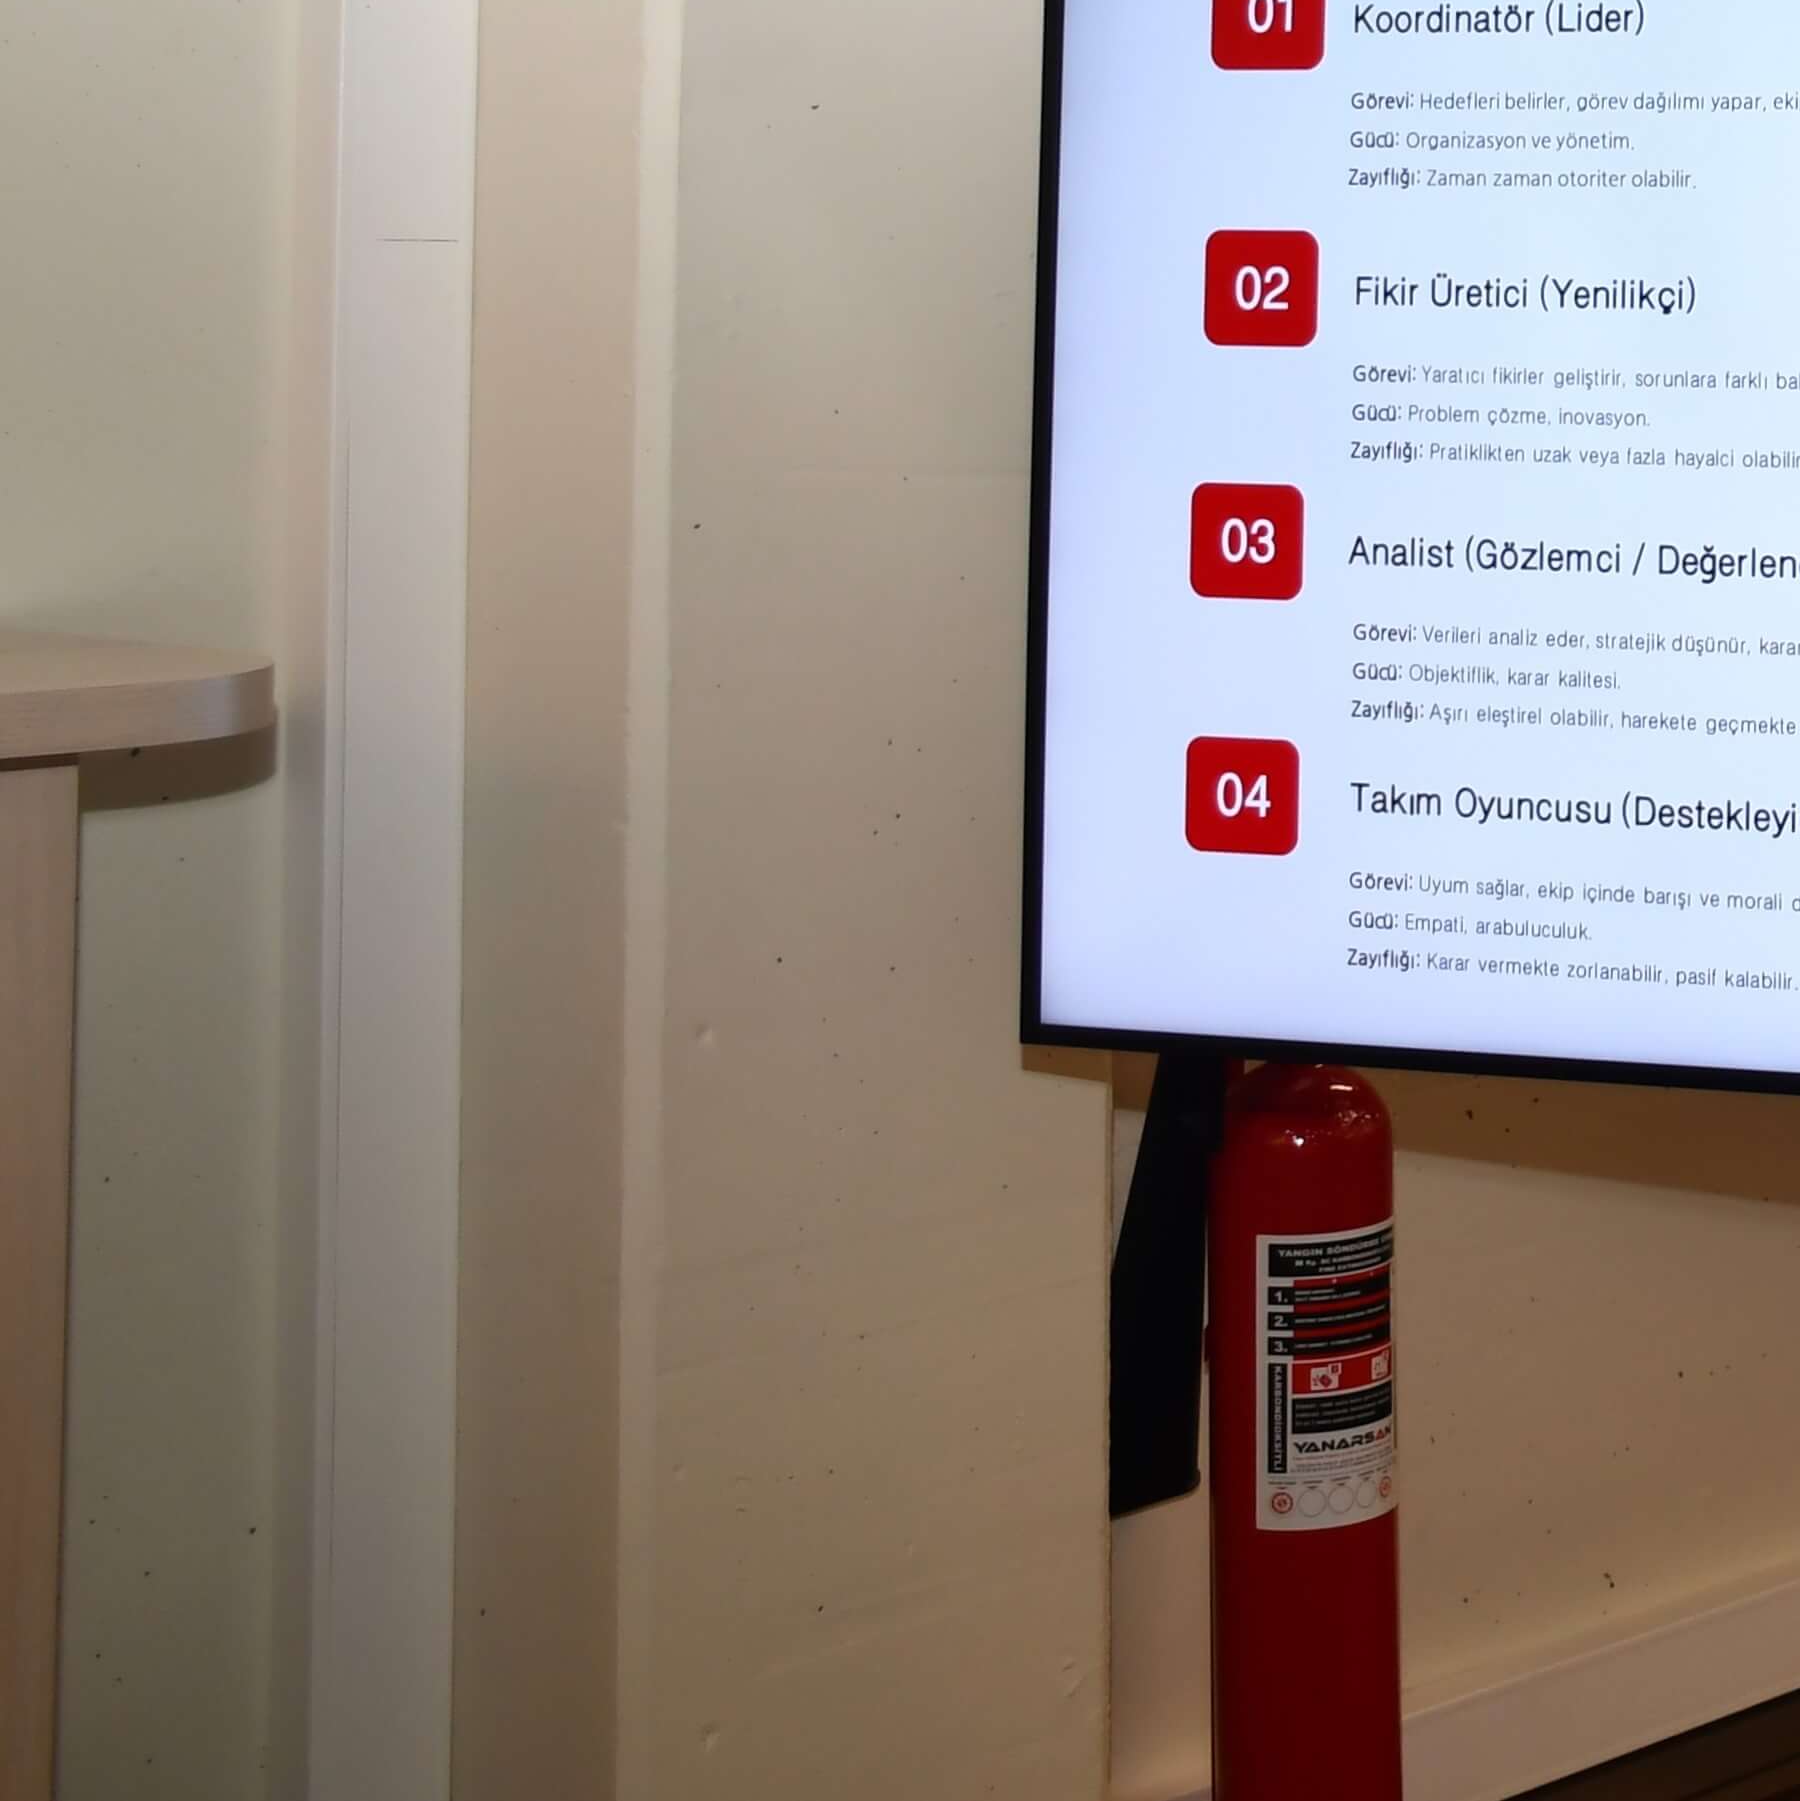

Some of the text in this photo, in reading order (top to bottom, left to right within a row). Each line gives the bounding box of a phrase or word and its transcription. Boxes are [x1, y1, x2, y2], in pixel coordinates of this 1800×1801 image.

[1353, 3, 1536, 34] Koordinatör
[1350, 91, 1415, 110] Görevi:
[1419, 92, 1501, 110] Hedefleri
[1576, 93, 1629, 112] görev
[1633, 92, 1705, 113] dağılımı
[1349, 131, 1635, 151] Gücü: Organizasyon ve yönetim.
[1347, 168, 1697, 189] Zayıflığı: Zaman zaman otoriter olabilir.
[1235, 265, 1290, 311] 02
[1355, 272, 1696, 315] Fikir Üretici (Yenilikçi)
[1351, 404, 1402, 422] Gücü:
[1407, 405, 1480, 422] Problem
[1558, 408, 1651, 429] inovasyon.
[1349, 441, 1424, 463] Zayıflığı:
[1429, 443, 1525, 462] Pratiklikten
[1532, 446, 1572, 463] uzak
[1578, 450, 1620, 467] veya
[1626, 448, 1666, 465] fazla
[1674, 448, 1735, 470] hayalci
[1221, 517, 1276, 564] 03
[1347, 536, 1455, 568] Analist
[1464, 534, 1621, 573] (Gözlemci
[1631, 542, 1647, 576] /
[1350, 700, 1425, 723] Zayıflığı:
[1428, 703, 1468, 725] Aşırı
[1476, 706, 1542, 728] eleştirel
[1621, 712, 1697, 731] harekete
[1705, 717, 1797, 736] geçmekte
[1216, 772, 1271, 818] 04
[1349, 782, 1442, 816] Takım
[1454, 787, 1612, 824] Oyuncusu
[1348, 872, 1413, 891] Görevi:
[1418, 875, 1469, 896] Uyum
[1537, 882, 1575, 902] ekip
[1582, 883, 1636, 904] içinde
[1643, 887, 1692, 910] barışı
[1699, 894, 1720, 907] ve
[1726, 893, 1783, 910] morali
[1348, 911, 1399, 930] Gücü:
[1475, 919, 1593, 940] arabuluculuk.
[1346, 948, 1421, 972] Zayıflığı:
[1426, 953, 1471, 971] Karar
[1478, 959, 1560, 976] vermekte
[1675, 968, 1717, 987] pasif
[1724, 970, 1799, 990] kalabilir.
[1273, 1290, 1288, 1303] 1.
[1273, 1315, 1288, 1328] 2.
[1273, 1340, 1288, 1353] 3.
[1293, 1425, 1391, 1453] YANARSAN
